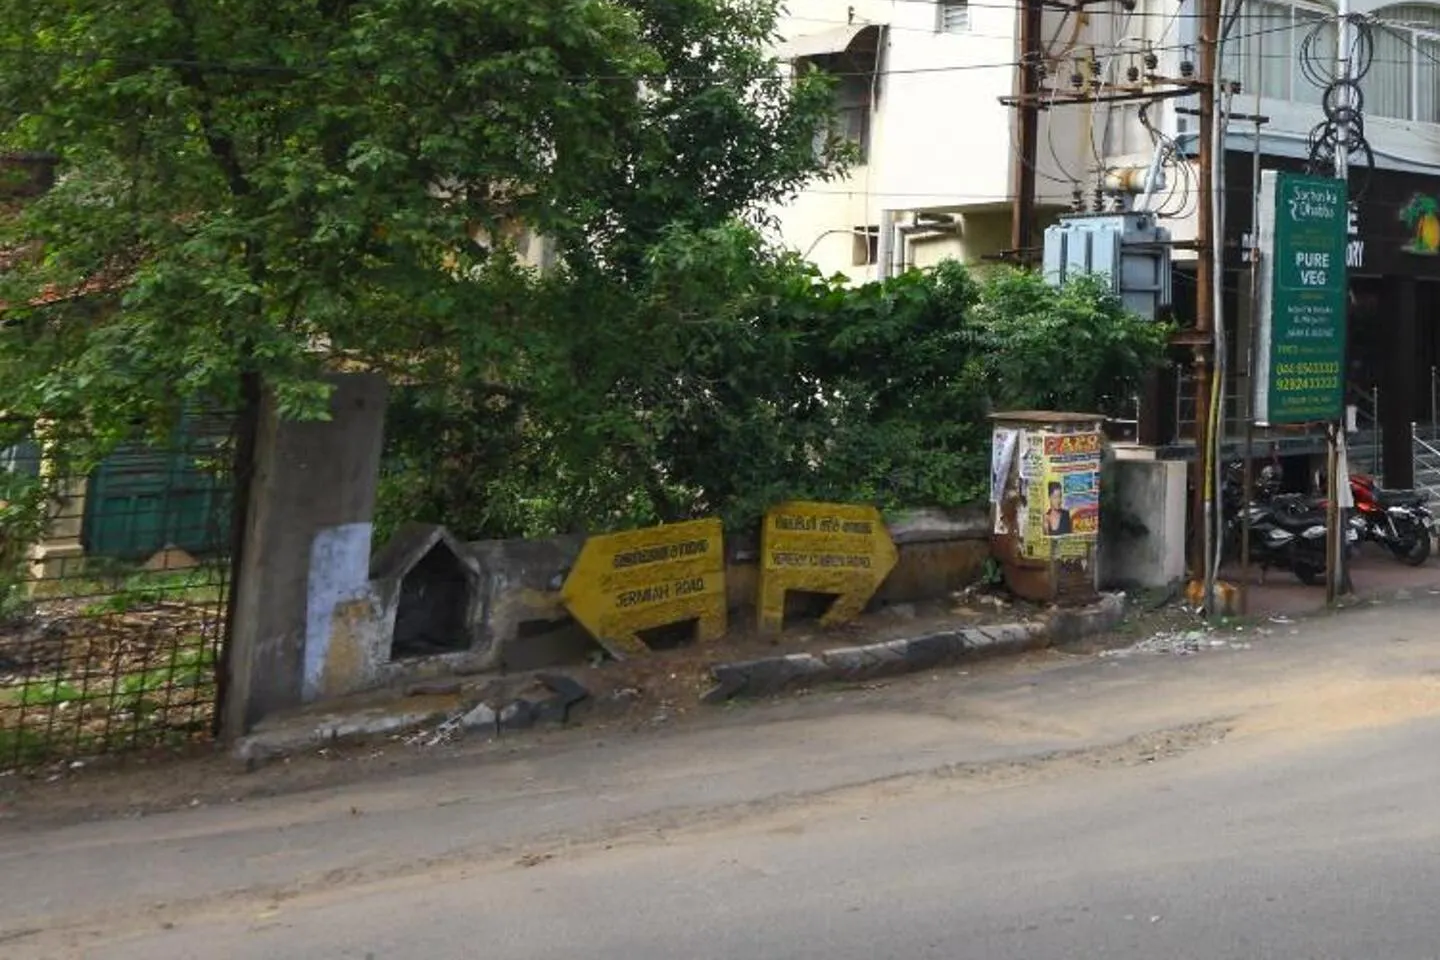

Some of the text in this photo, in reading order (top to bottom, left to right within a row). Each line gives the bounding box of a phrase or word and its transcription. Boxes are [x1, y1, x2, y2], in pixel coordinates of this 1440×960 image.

[1295, 251, 1330, 268] PURE
[1301, 270, 1326, 285] VEG
[675, 577, 705, 597] ROAD
